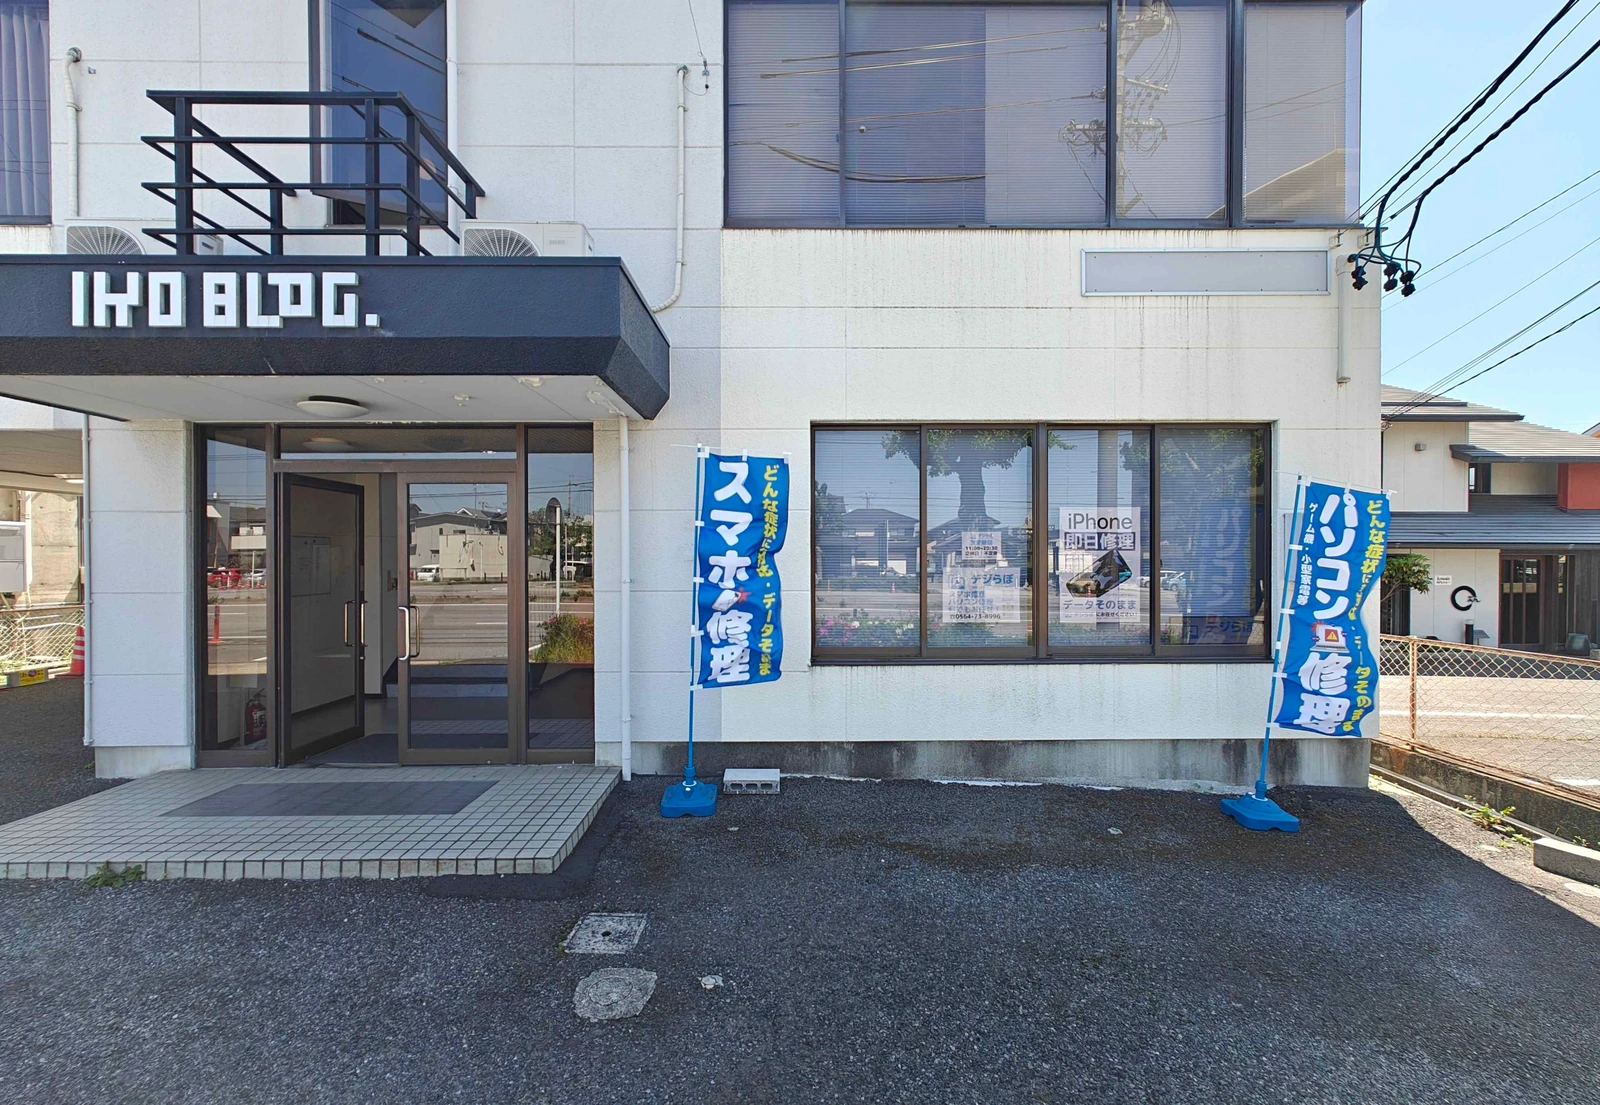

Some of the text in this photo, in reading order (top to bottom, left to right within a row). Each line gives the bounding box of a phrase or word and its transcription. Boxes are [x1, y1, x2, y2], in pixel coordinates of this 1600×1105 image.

[202, 270, 381, 329] BLDG.
[1068, 512, 1133, 530] iPhone
[1066, 533, 1134, 550] 即日修理
[706, 460, 754, 684] スマホ 修理
[1063, 600, 1137, 610] データそのまま
[1293, 493, 1359, 735] パソコン 修理
